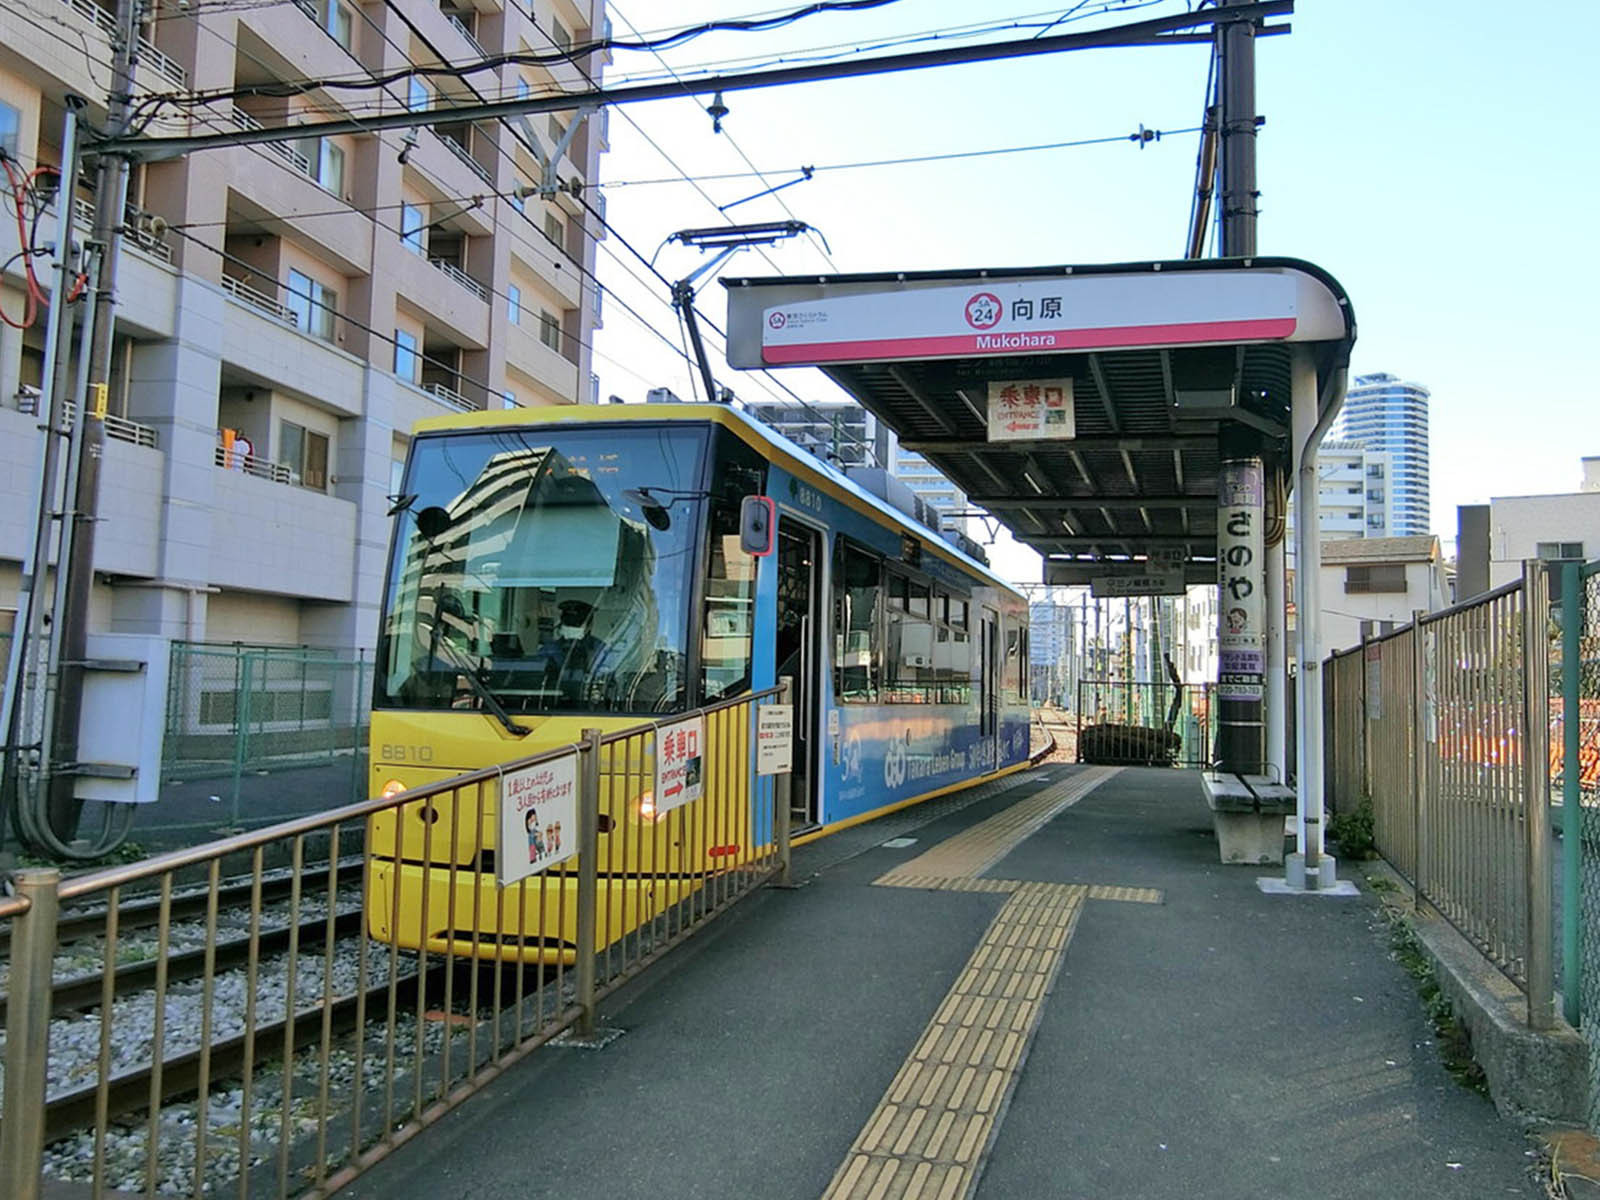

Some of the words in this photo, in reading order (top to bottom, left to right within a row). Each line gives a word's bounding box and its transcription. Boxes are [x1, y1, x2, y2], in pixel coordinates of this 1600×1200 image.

[974, 308, 993, 322] 24
[1011, 297, 1063, 321] 向原
[976, 334, 1056, 349] Mukohara
[1000, 384, 1064, 408] 乗車口
[1226, 511, 1253, 600] さのや
[664, 729, 697, 766] 乗車口
